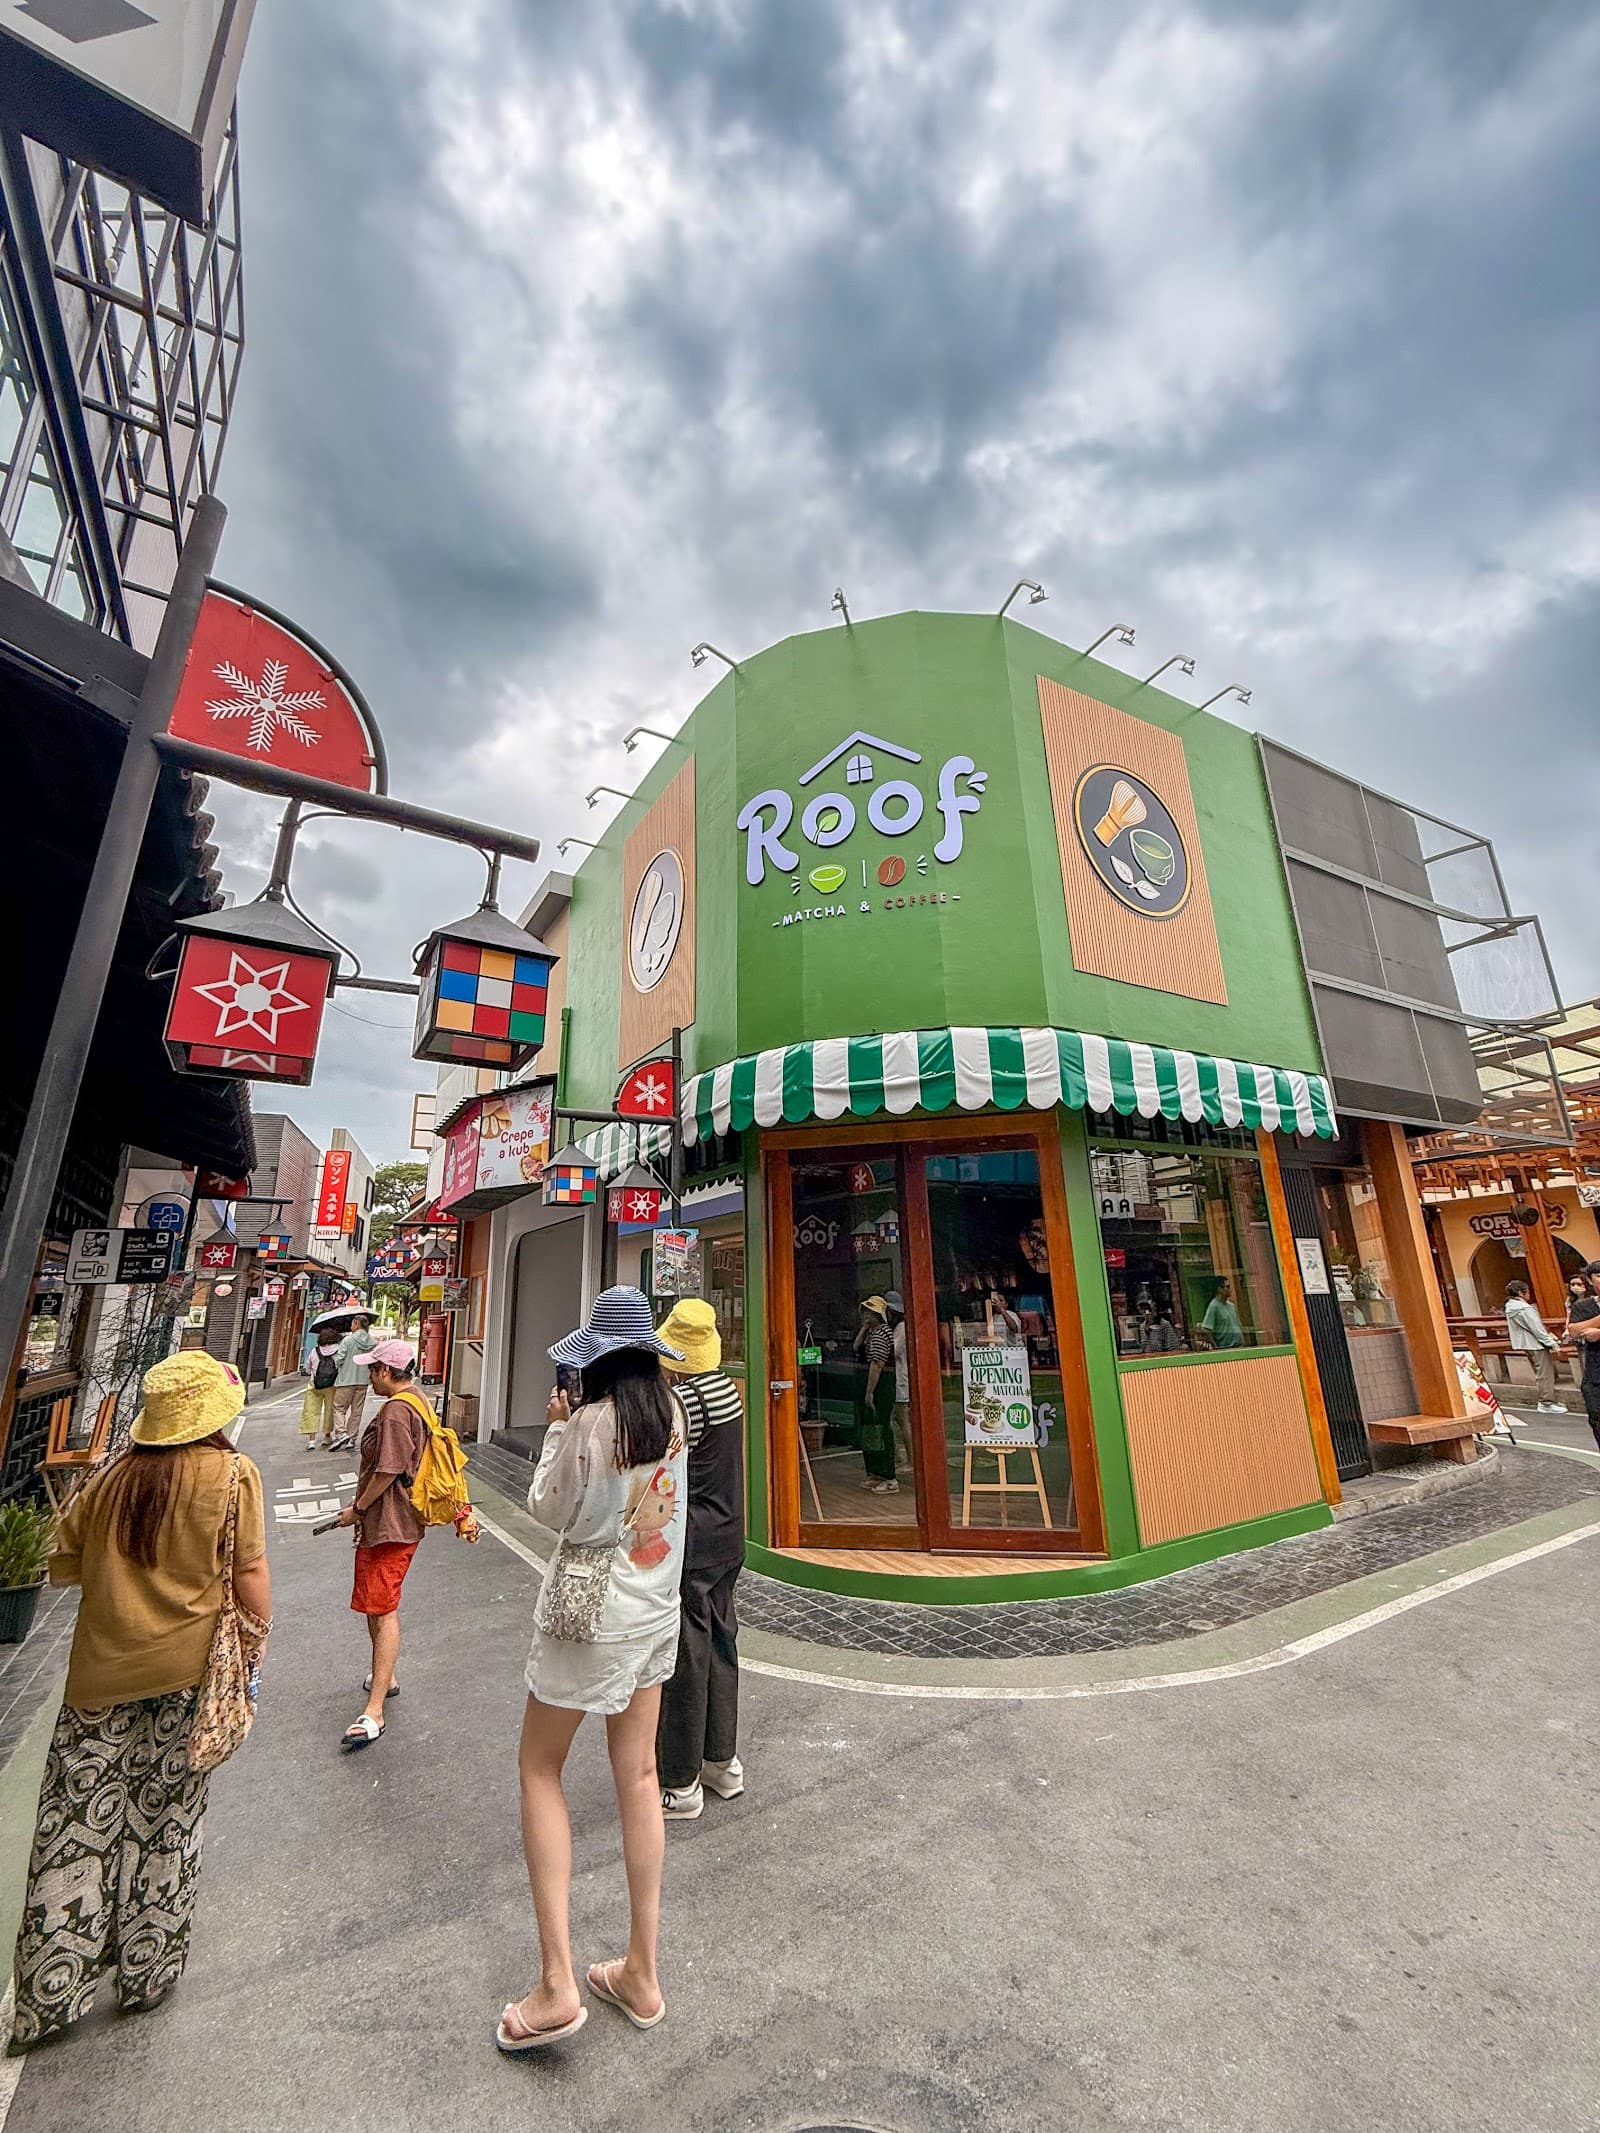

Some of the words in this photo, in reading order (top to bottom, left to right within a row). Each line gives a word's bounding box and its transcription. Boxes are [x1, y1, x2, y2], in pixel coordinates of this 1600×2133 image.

[737, 755, 981, 886] Roof
[782, 904, 846, 927] MATCHA
[859, 901, 871, 914] &
[883, 891, 948, 910] COFFEE
[500, 1129, 534, 1144] Crepe
[499, 1150, 505, 1159] a
[508, 1143, 530, 1158] kub
[317, 1229, 339, 1237] KIRIN
[972, 1352, 1001, 1366] GRAND
[970, 1367, 1023, 1384] OPENING
[993, 1385, 1024, 1396] MATCHA
[984, 1405, 1002, 1422] Roof
[1009, 1408, 1023, 1416] BUY
[1023, 1408, 1028, 1424] 1
[1010, 1415, 1022, 1425] GET
